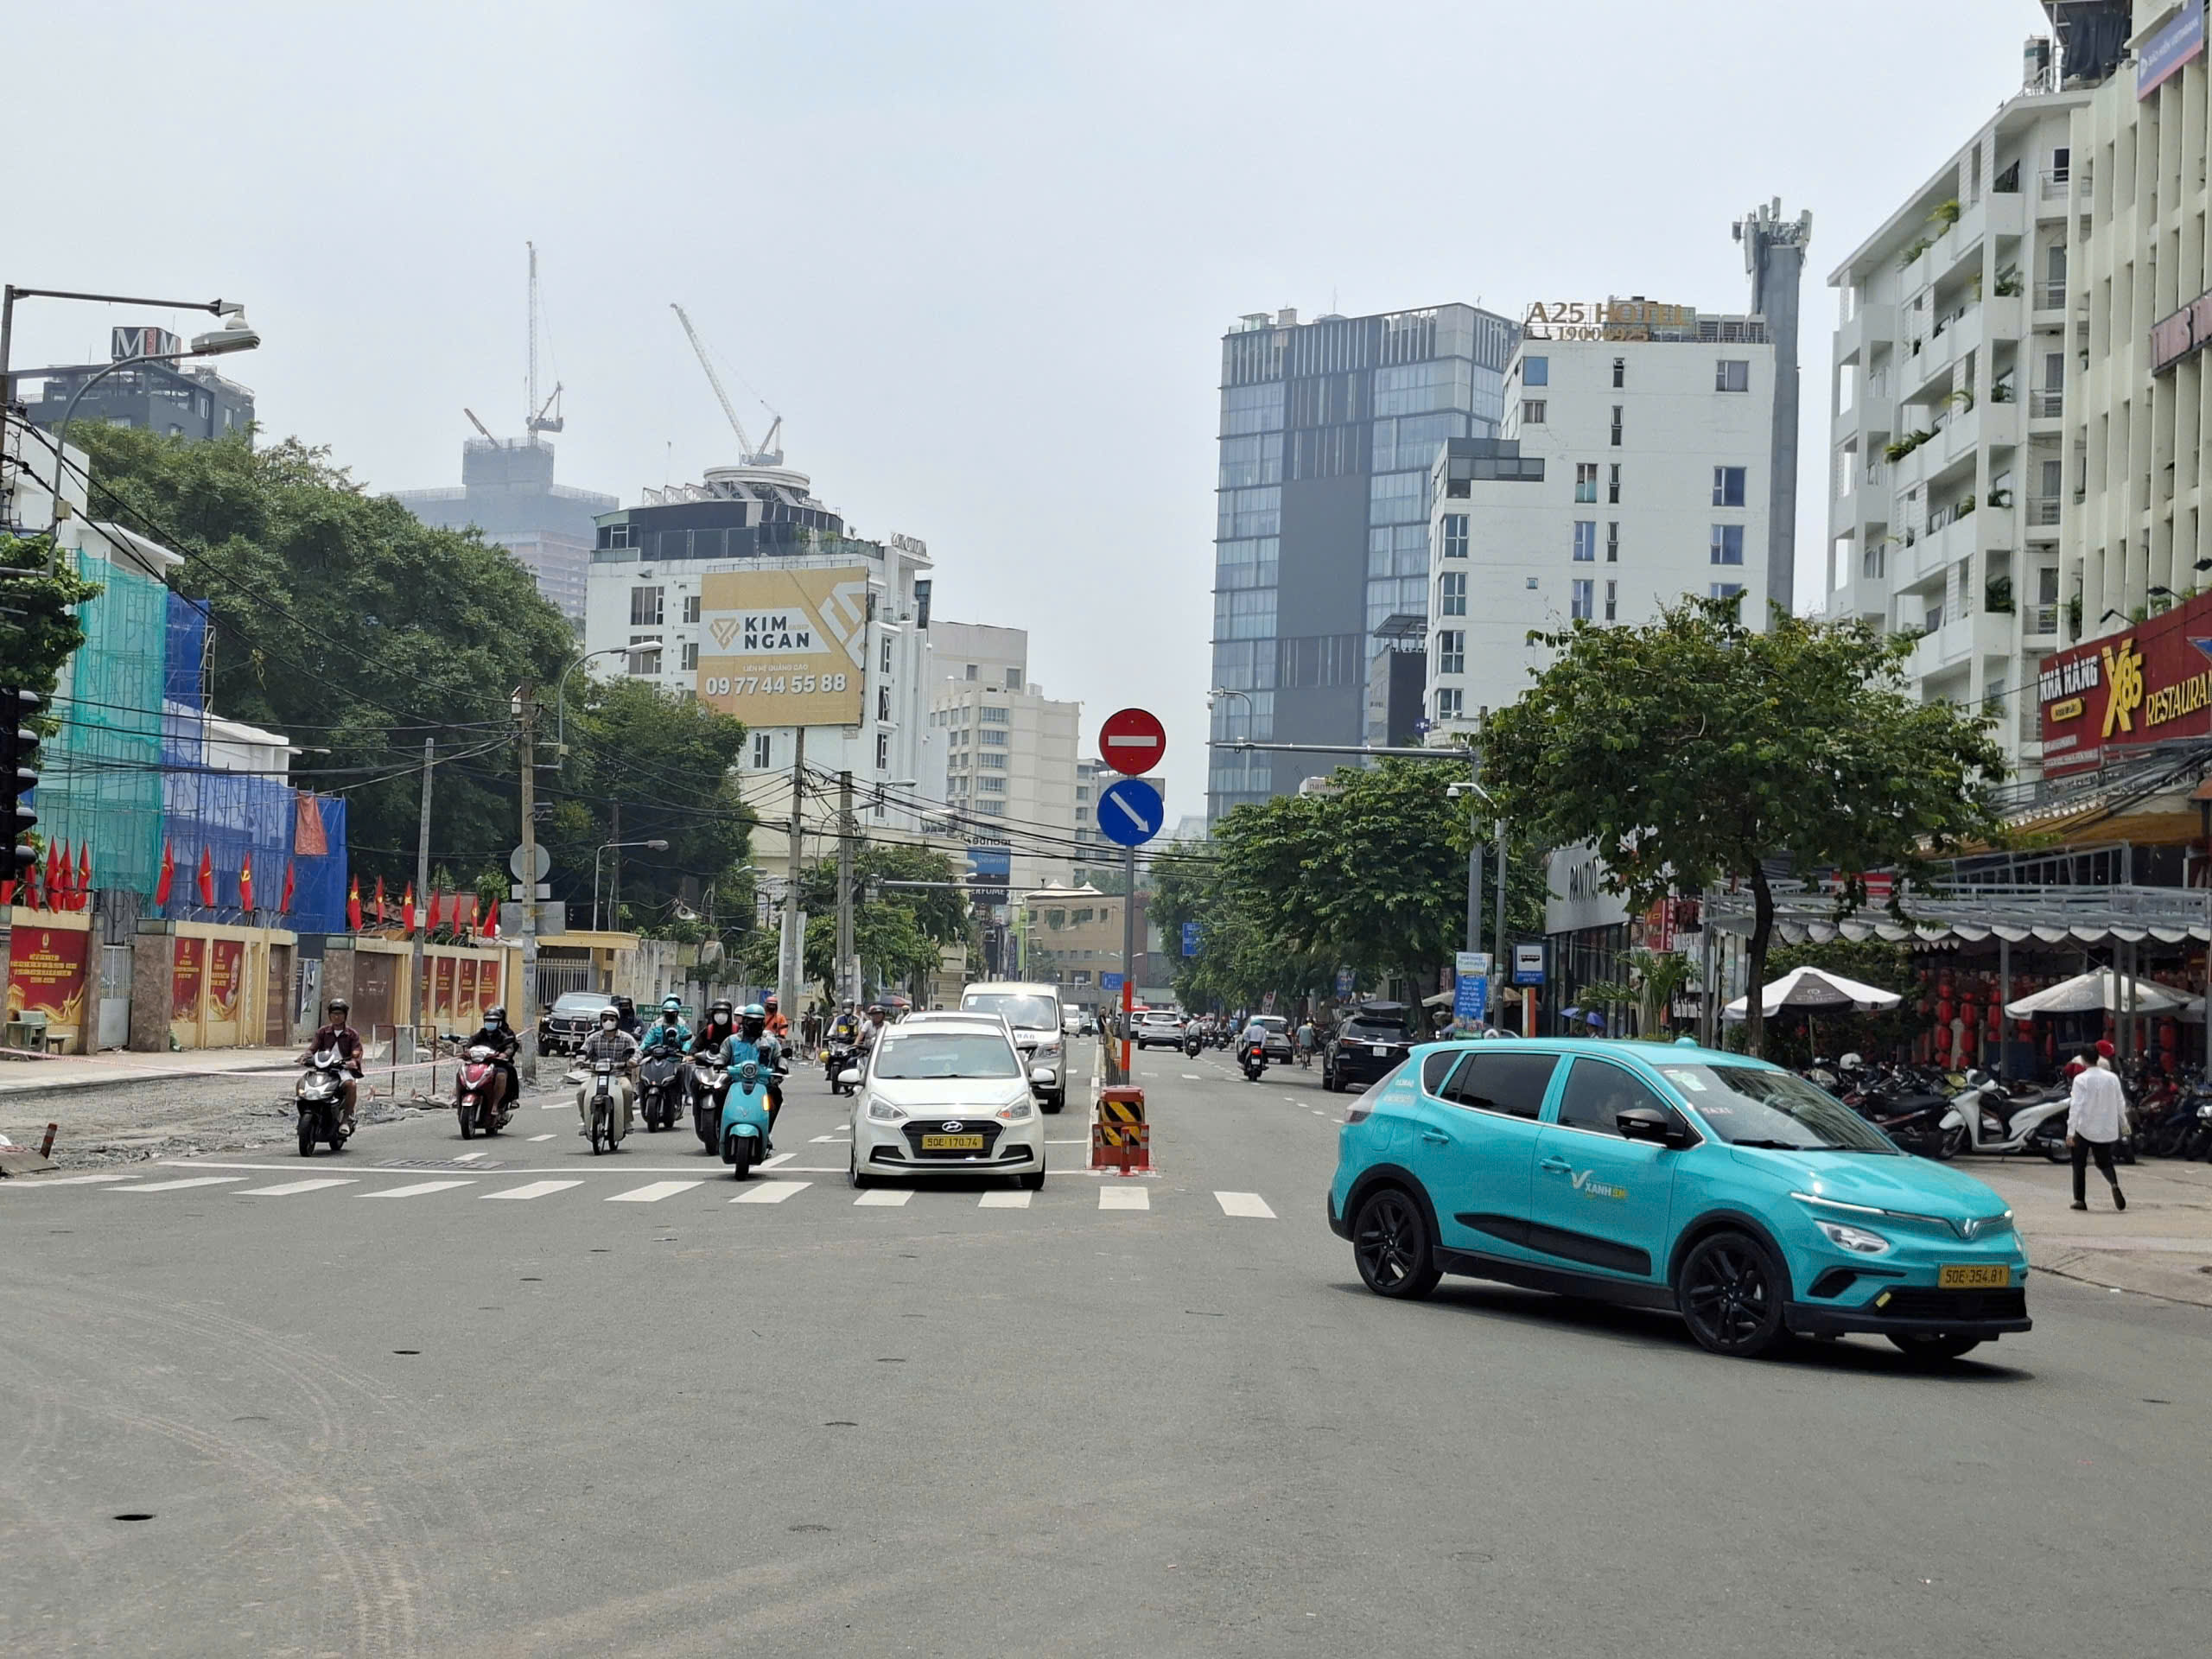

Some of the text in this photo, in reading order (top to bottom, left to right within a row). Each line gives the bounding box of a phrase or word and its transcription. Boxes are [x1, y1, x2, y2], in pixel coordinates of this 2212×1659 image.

[1528, 302, 1688, 325] A25 HOTEL
[745, 616, 787, 632] KIM
[744, 632, 810, 650] NGAN
[705, 673, 847, 696] 09 77 44 55 88
[2039, 654, 2099, 702] NHÀ HÀNG
[1585, 1180, 1611, 1197] XANH
